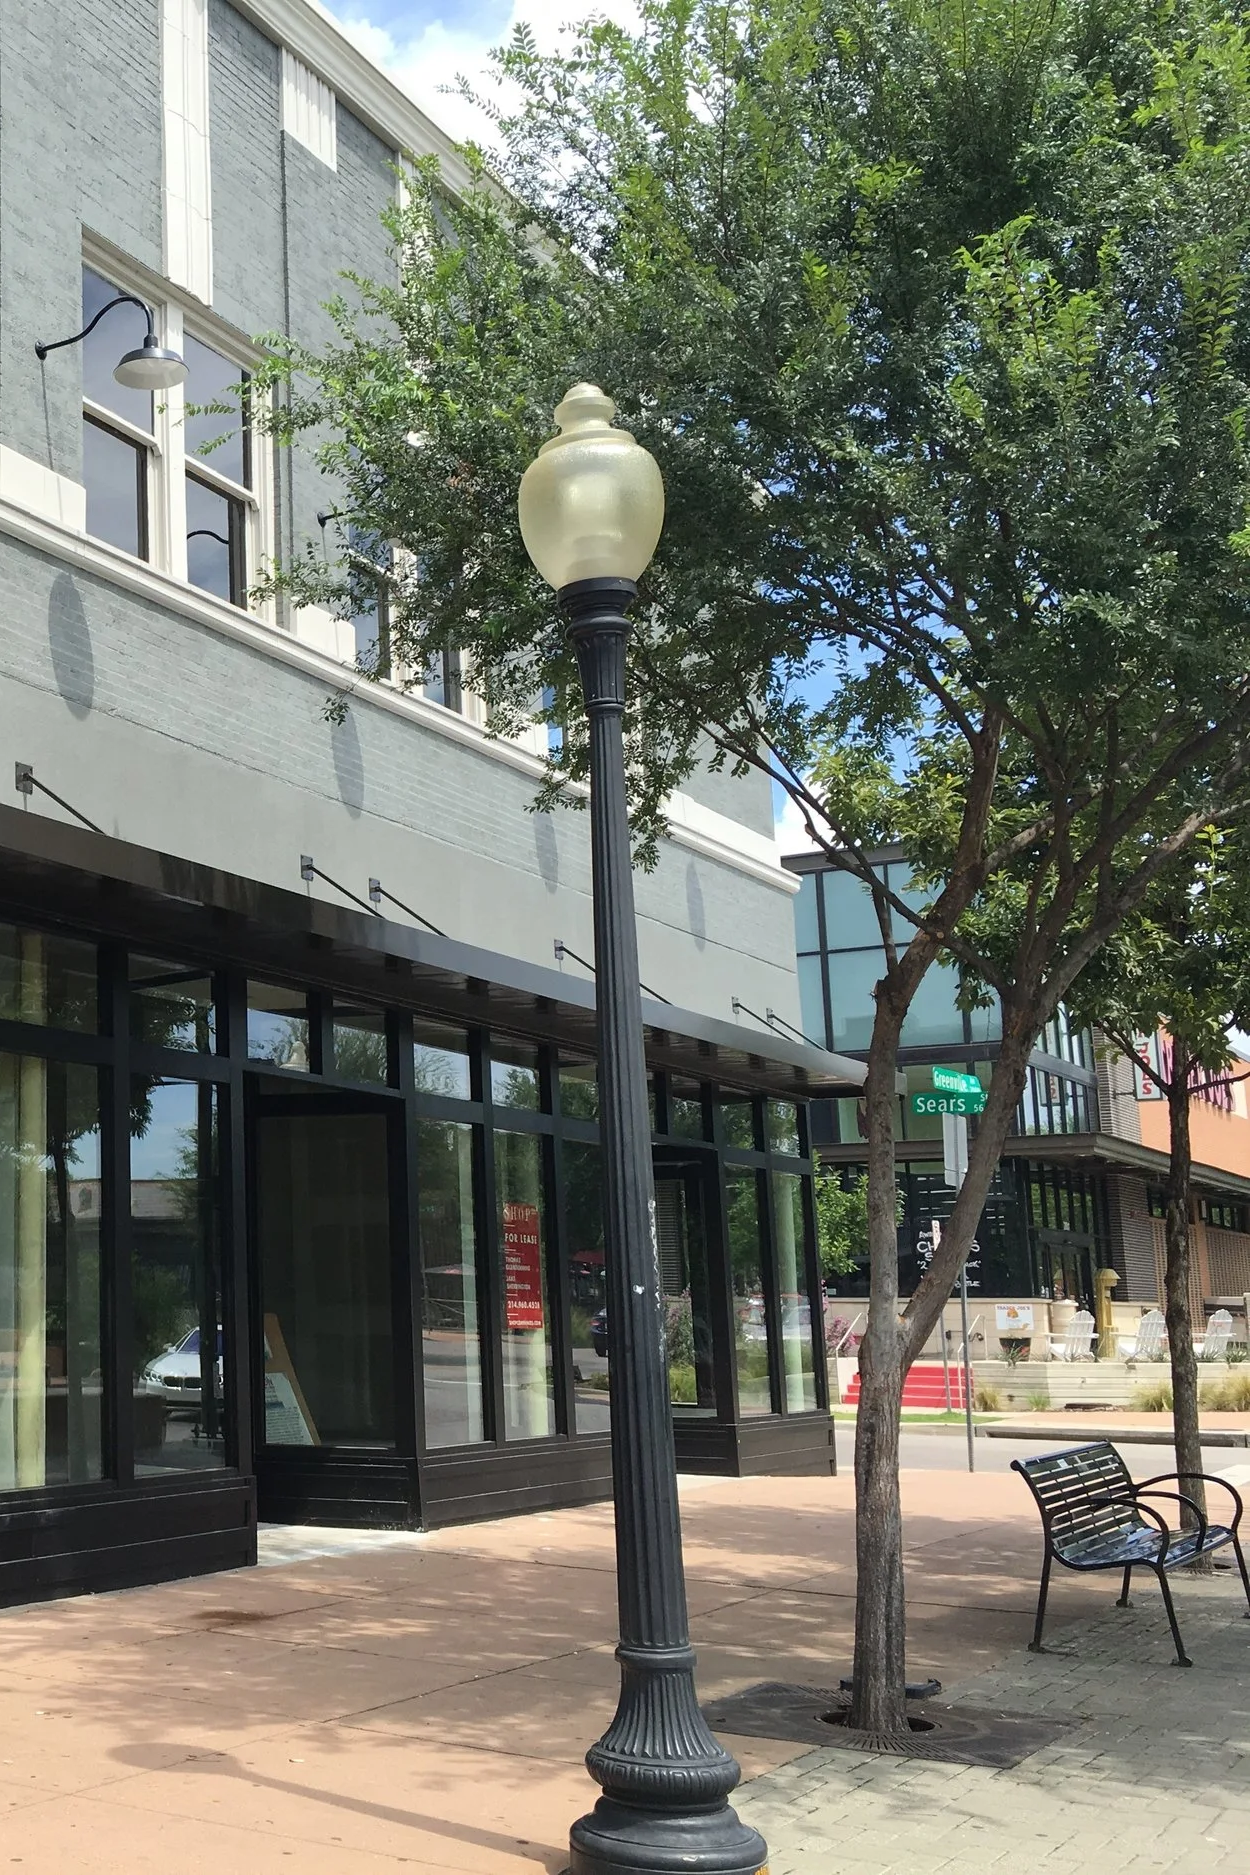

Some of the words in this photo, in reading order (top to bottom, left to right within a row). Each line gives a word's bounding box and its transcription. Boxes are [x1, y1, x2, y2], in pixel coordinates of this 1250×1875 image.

[934, 1070, 967, 1092] Greenville
[916, 1097, 966, 1113] Sears
[505, 1232, 518, 1243] FOR
[520, 1234, 537, 1245] LEASE
